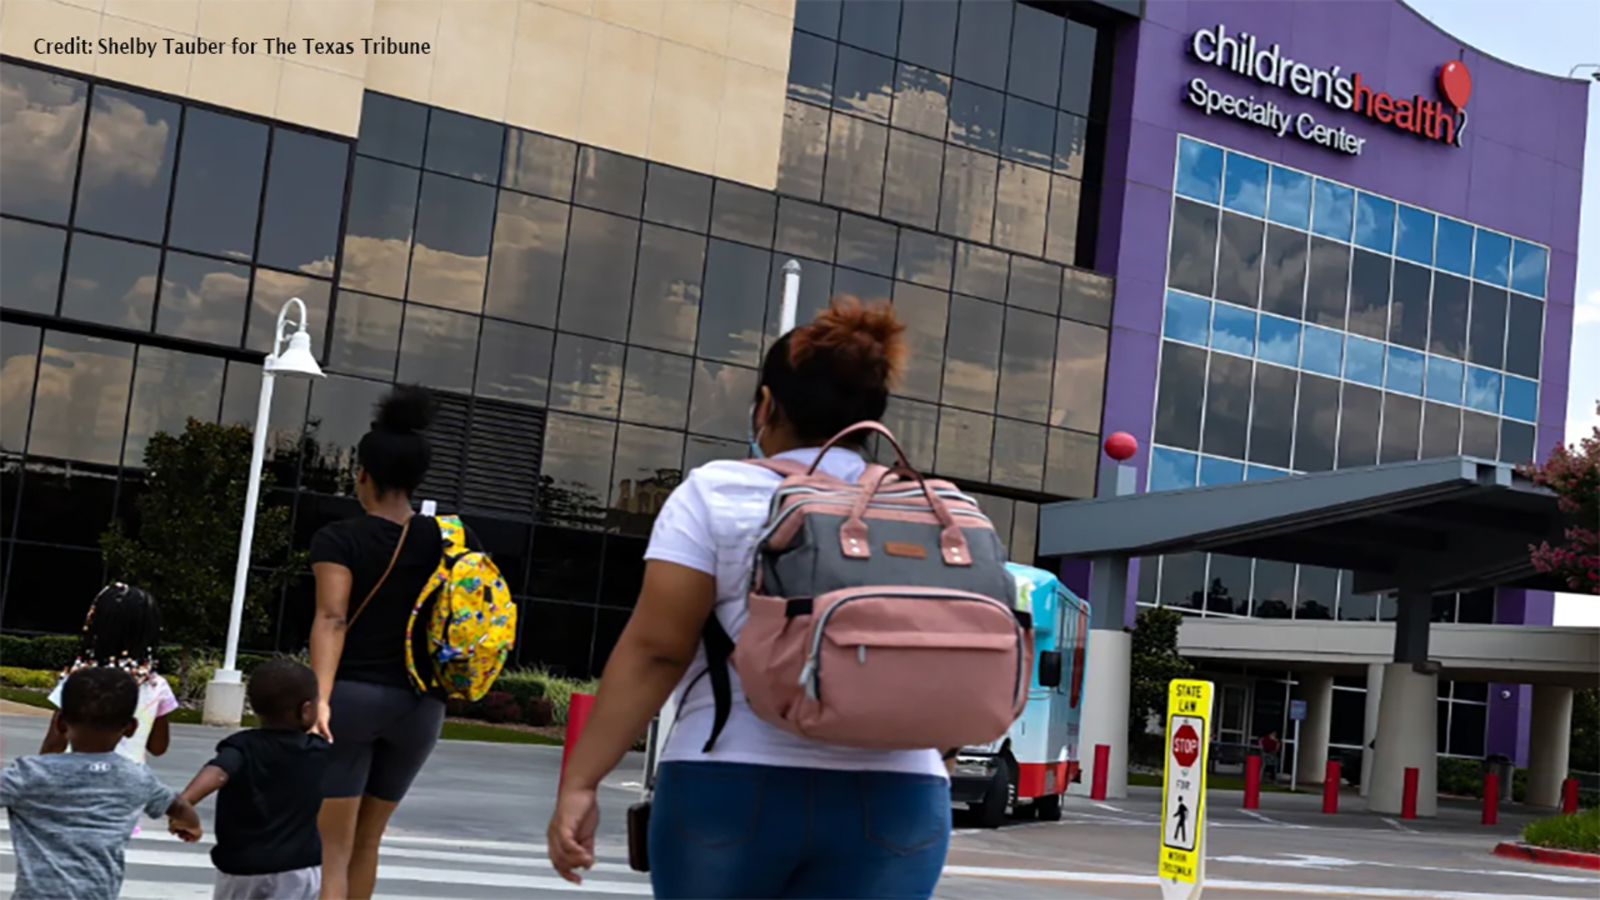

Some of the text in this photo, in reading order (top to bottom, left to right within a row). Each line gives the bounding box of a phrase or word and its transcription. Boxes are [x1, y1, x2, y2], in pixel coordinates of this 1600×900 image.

[1189, 77, 1367, 156] Specialty Center
[1176, 684, 1202, 699] STATE
[1178, 700, 1197, 713] LAW
[1173, 737, 1198, 754] STOP
